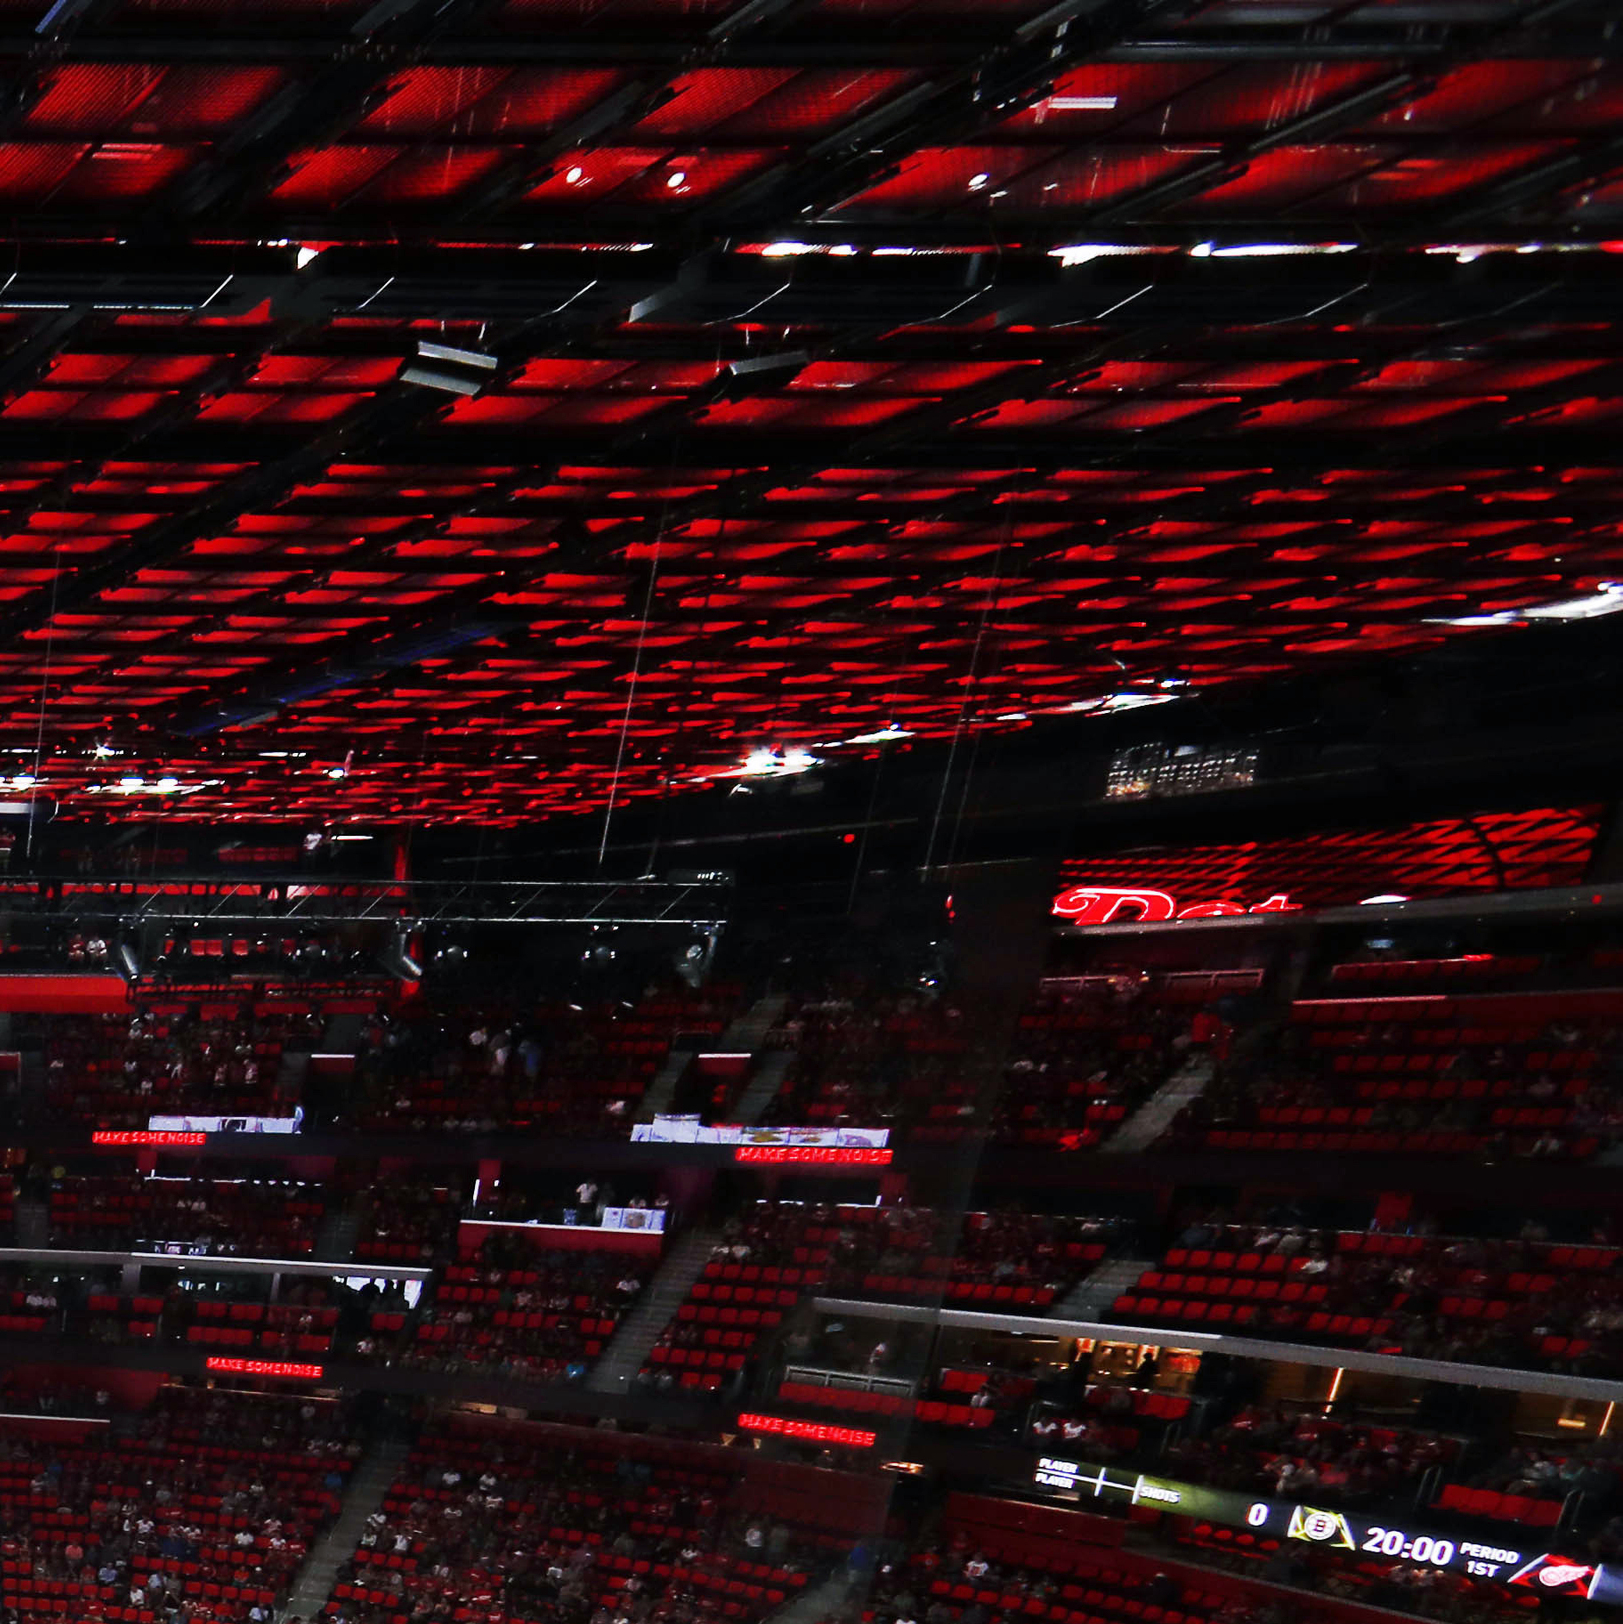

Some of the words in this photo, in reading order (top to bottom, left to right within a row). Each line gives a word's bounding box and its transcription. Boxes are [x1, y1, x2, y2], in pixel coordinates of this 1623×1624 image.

[739, 1148, 784, 1160] MAKE
[1038, 1457, 1078, 1474] PLAYER
[1034, 1472, 1074, 1490] PLAYER
[1139, 1483, 1180, 1504] SHOTS
[1247, 1503, 1268, 1527] 0
[1362, 1526, 1454, 1567] 20:00
[1459, 1542, 1519, 1564] PERIOD
[1466, 1560, 1499, 1578] 1ST
